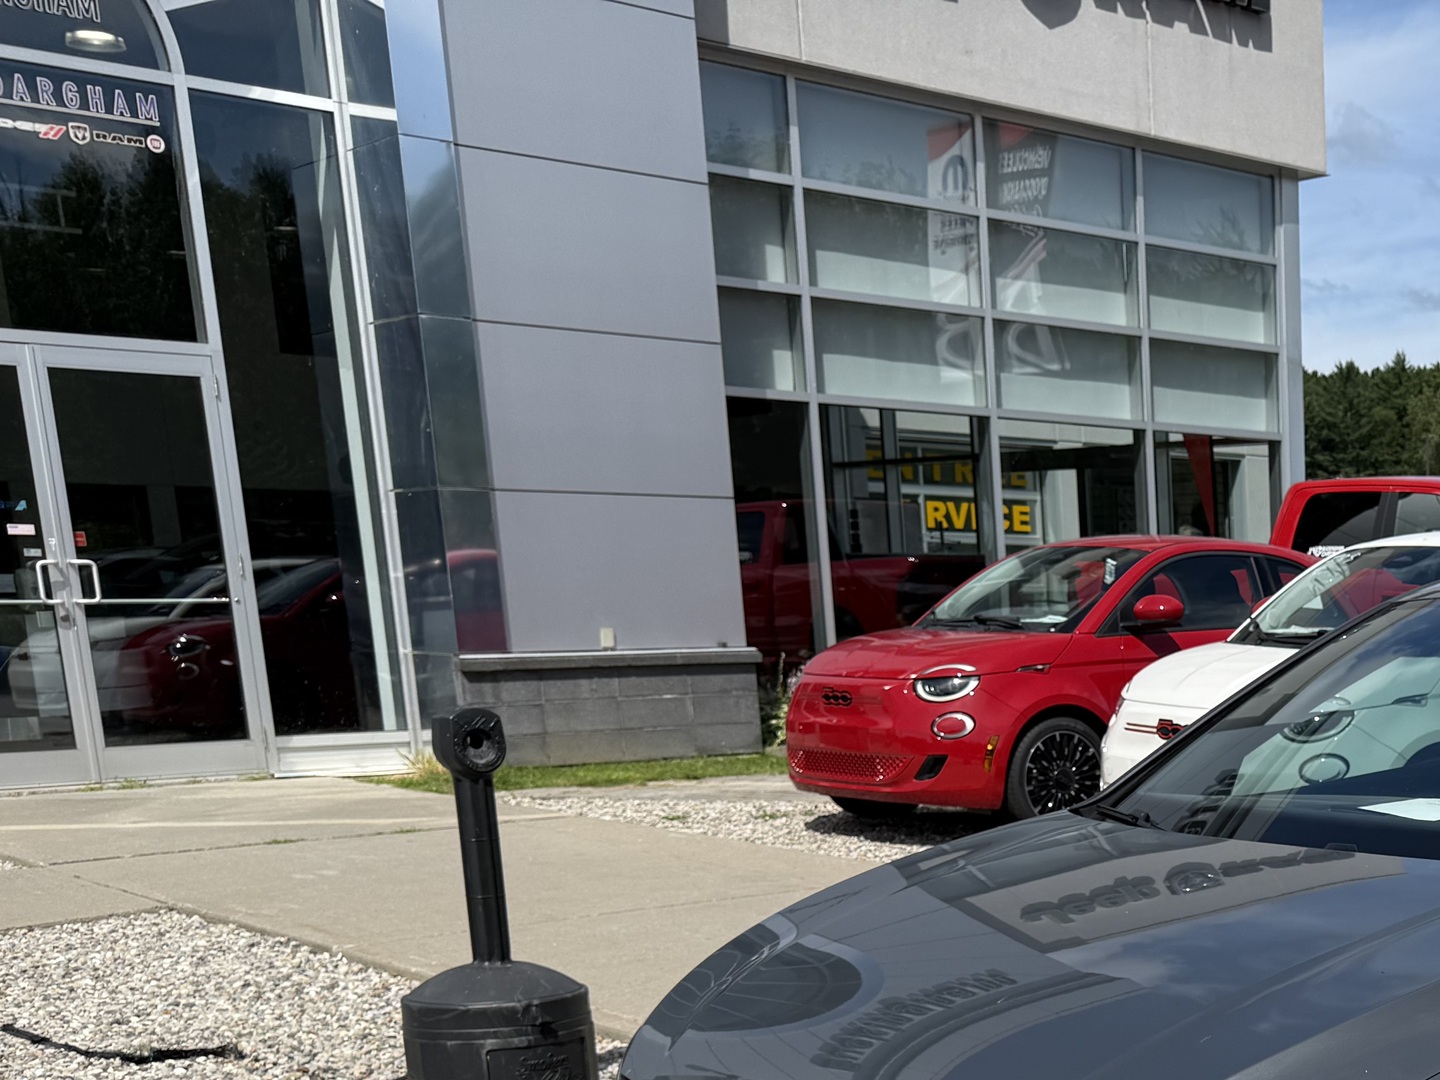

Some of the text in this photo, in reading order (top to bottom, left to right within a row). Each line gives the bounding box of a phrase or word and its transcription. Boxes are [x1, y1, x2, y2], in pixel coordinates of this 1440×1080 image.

[0, 73, 159, 121] ARGHAM
[94, 131, 145, 147] RAM
[866, 450, 1028, 488] ENTRE
[926, 501, 1032, 533] RVIE
[1157, 718, 1188, 740] 50
